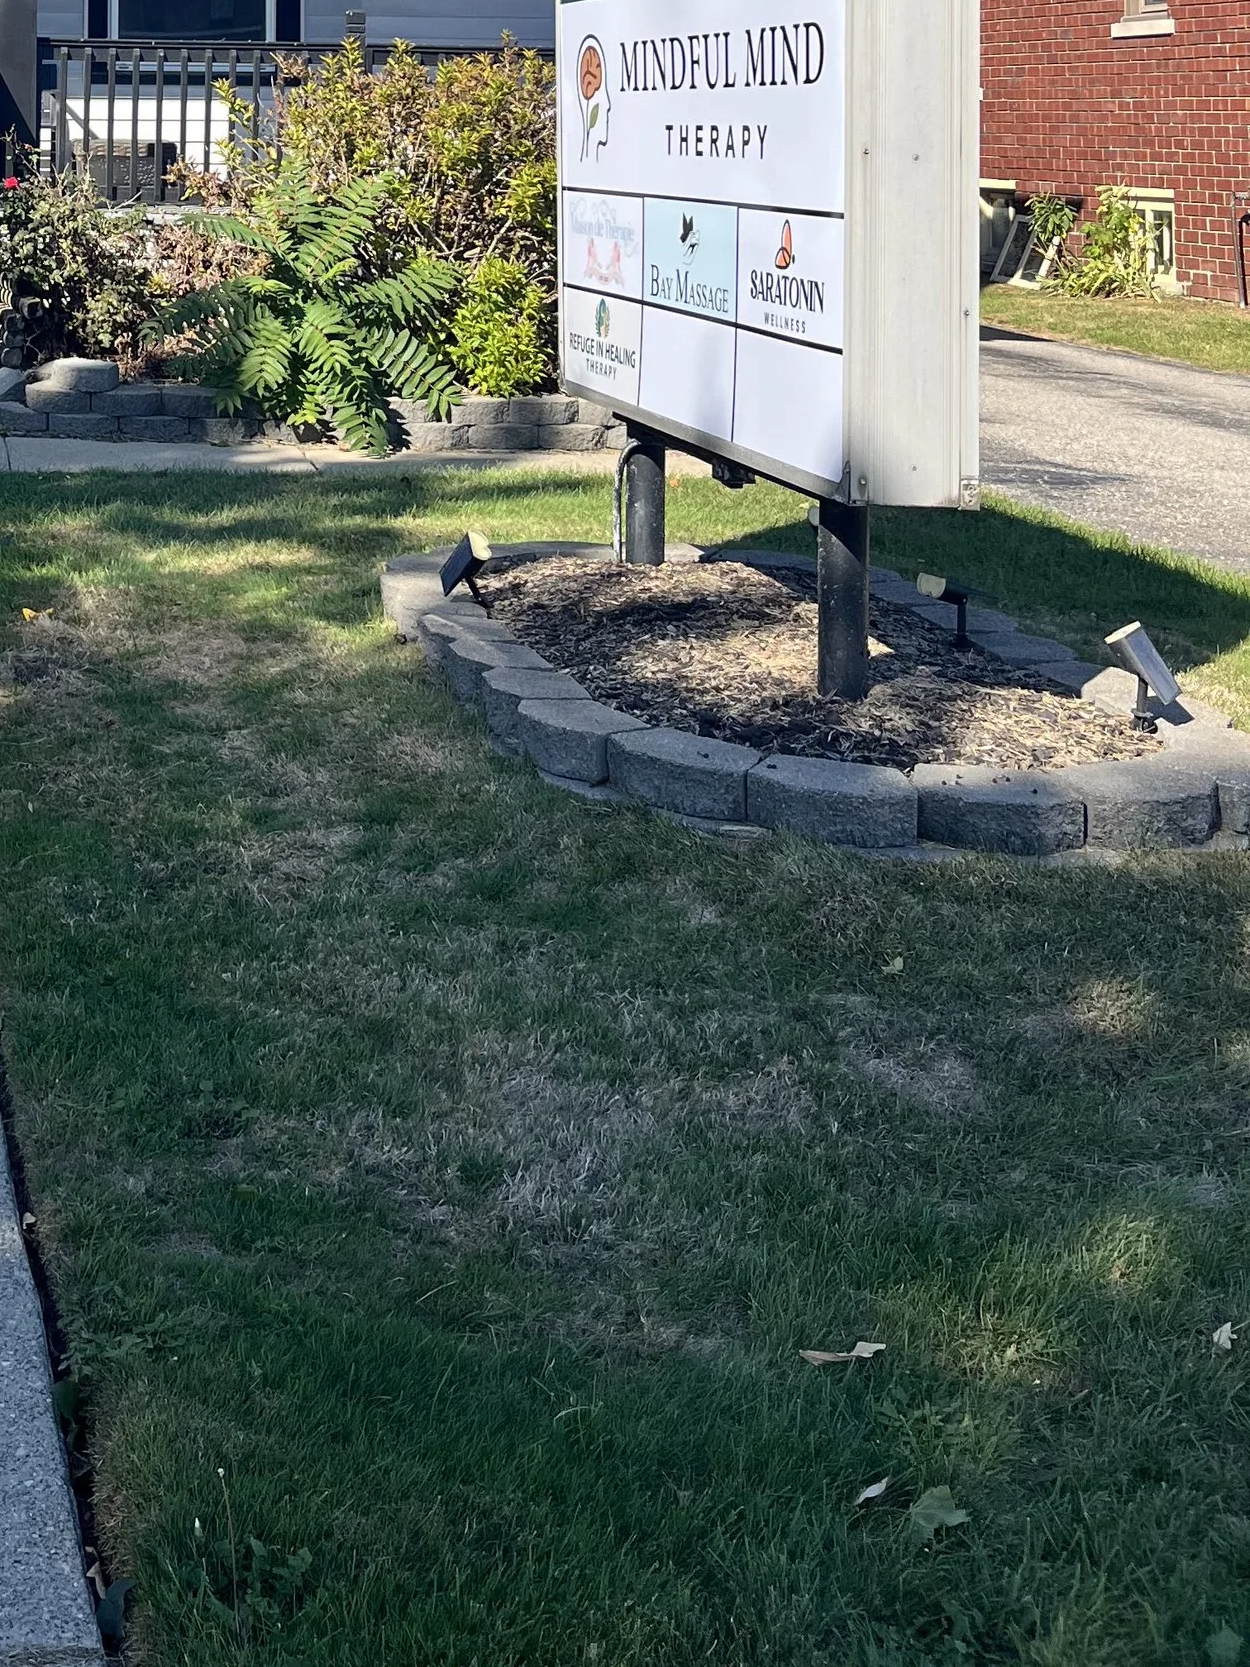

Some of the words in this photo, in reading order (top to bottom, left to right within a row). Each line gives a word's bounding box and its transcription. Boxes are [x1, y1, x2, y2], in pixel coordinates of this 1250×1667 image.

[619, 32, 737, 93] MINDFUL
[744, 21, 825, 88] MIND
[665, 124, 768, 160] THERAPY
[675, 269, 730, 314] MASSAGE
[750, 269, 825, 315] SARATONIN
[764, 312, 806, 334] WELLNESS
[569, 332, 595, 356] REFUGE
[596, 339, 604, 358] IN
[605, 343, 636, 369] HEALING
[586, 357, 617, 380] THERAPY
